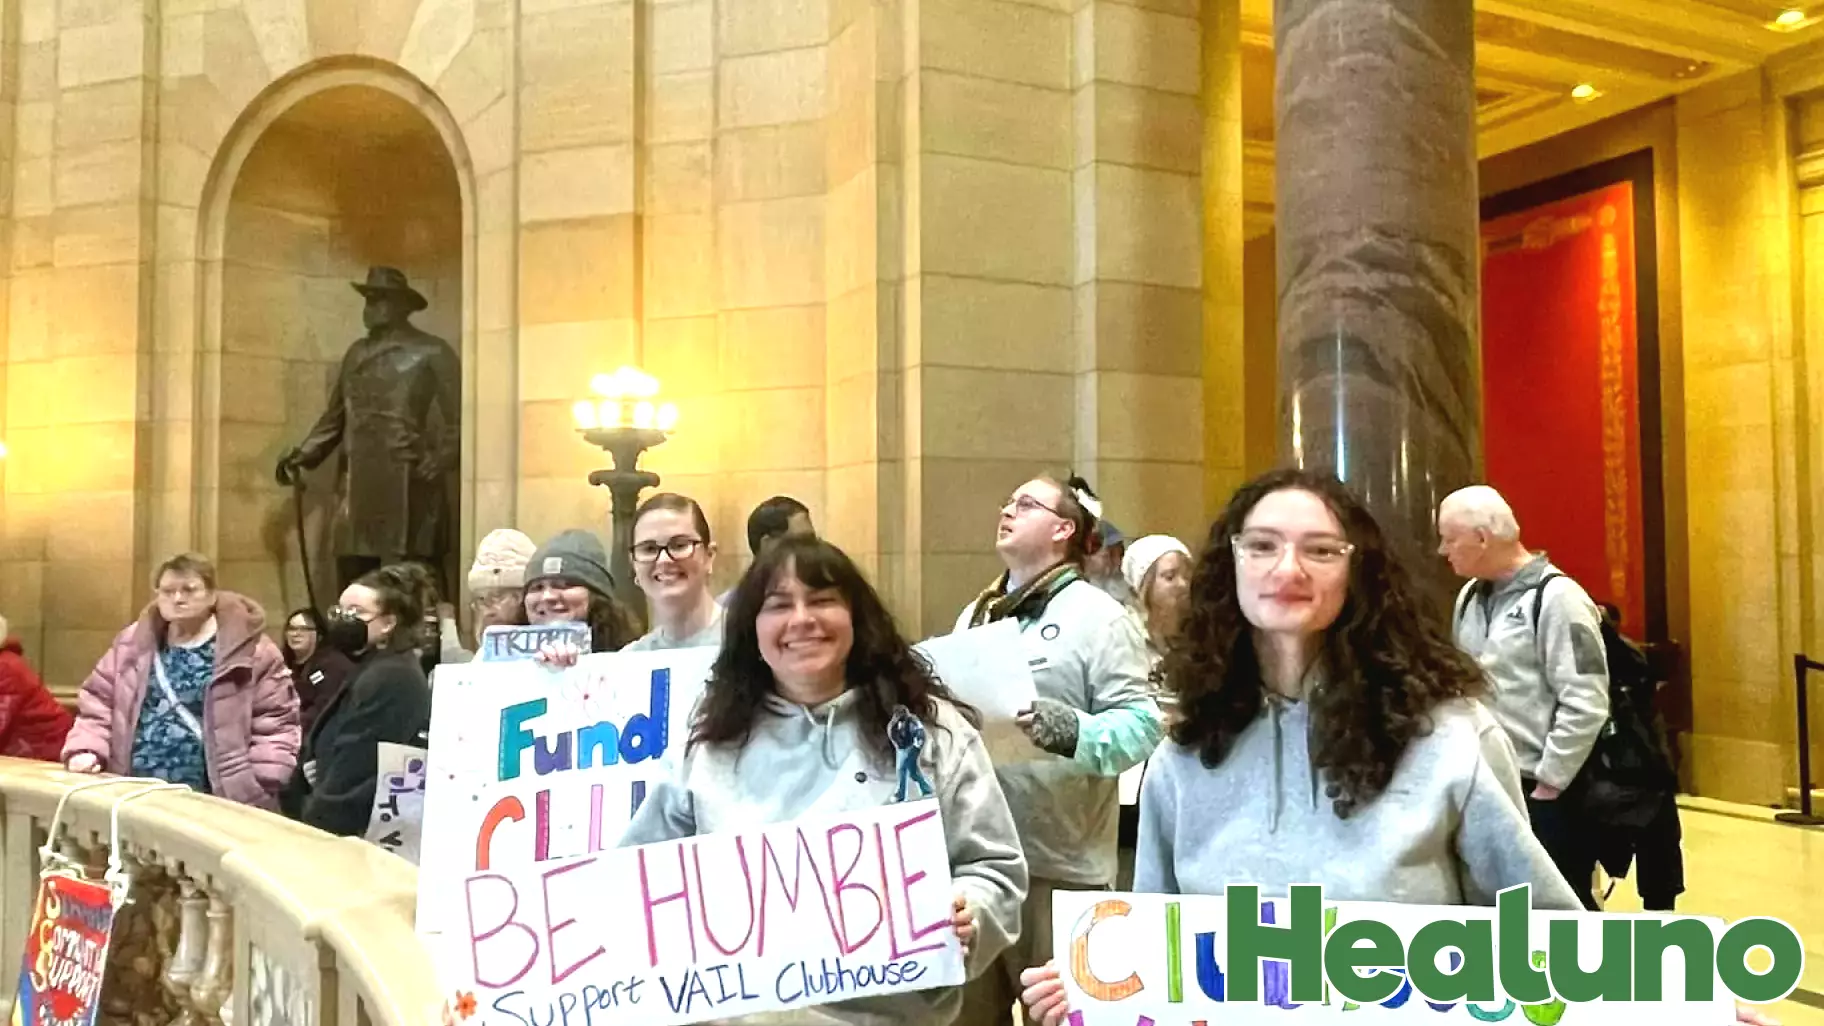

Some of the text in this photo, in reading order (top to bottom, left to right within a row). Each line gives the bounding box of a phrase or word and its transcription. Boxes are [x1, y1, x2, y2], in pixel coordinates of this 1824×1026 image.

[497, 667, 670, 781] Fund
[465, 857, 606, 989] BE
[637, 808, 953, 967] HUMBLE
[492, 957, 929, 1026] Support VAIL Clubhouse
